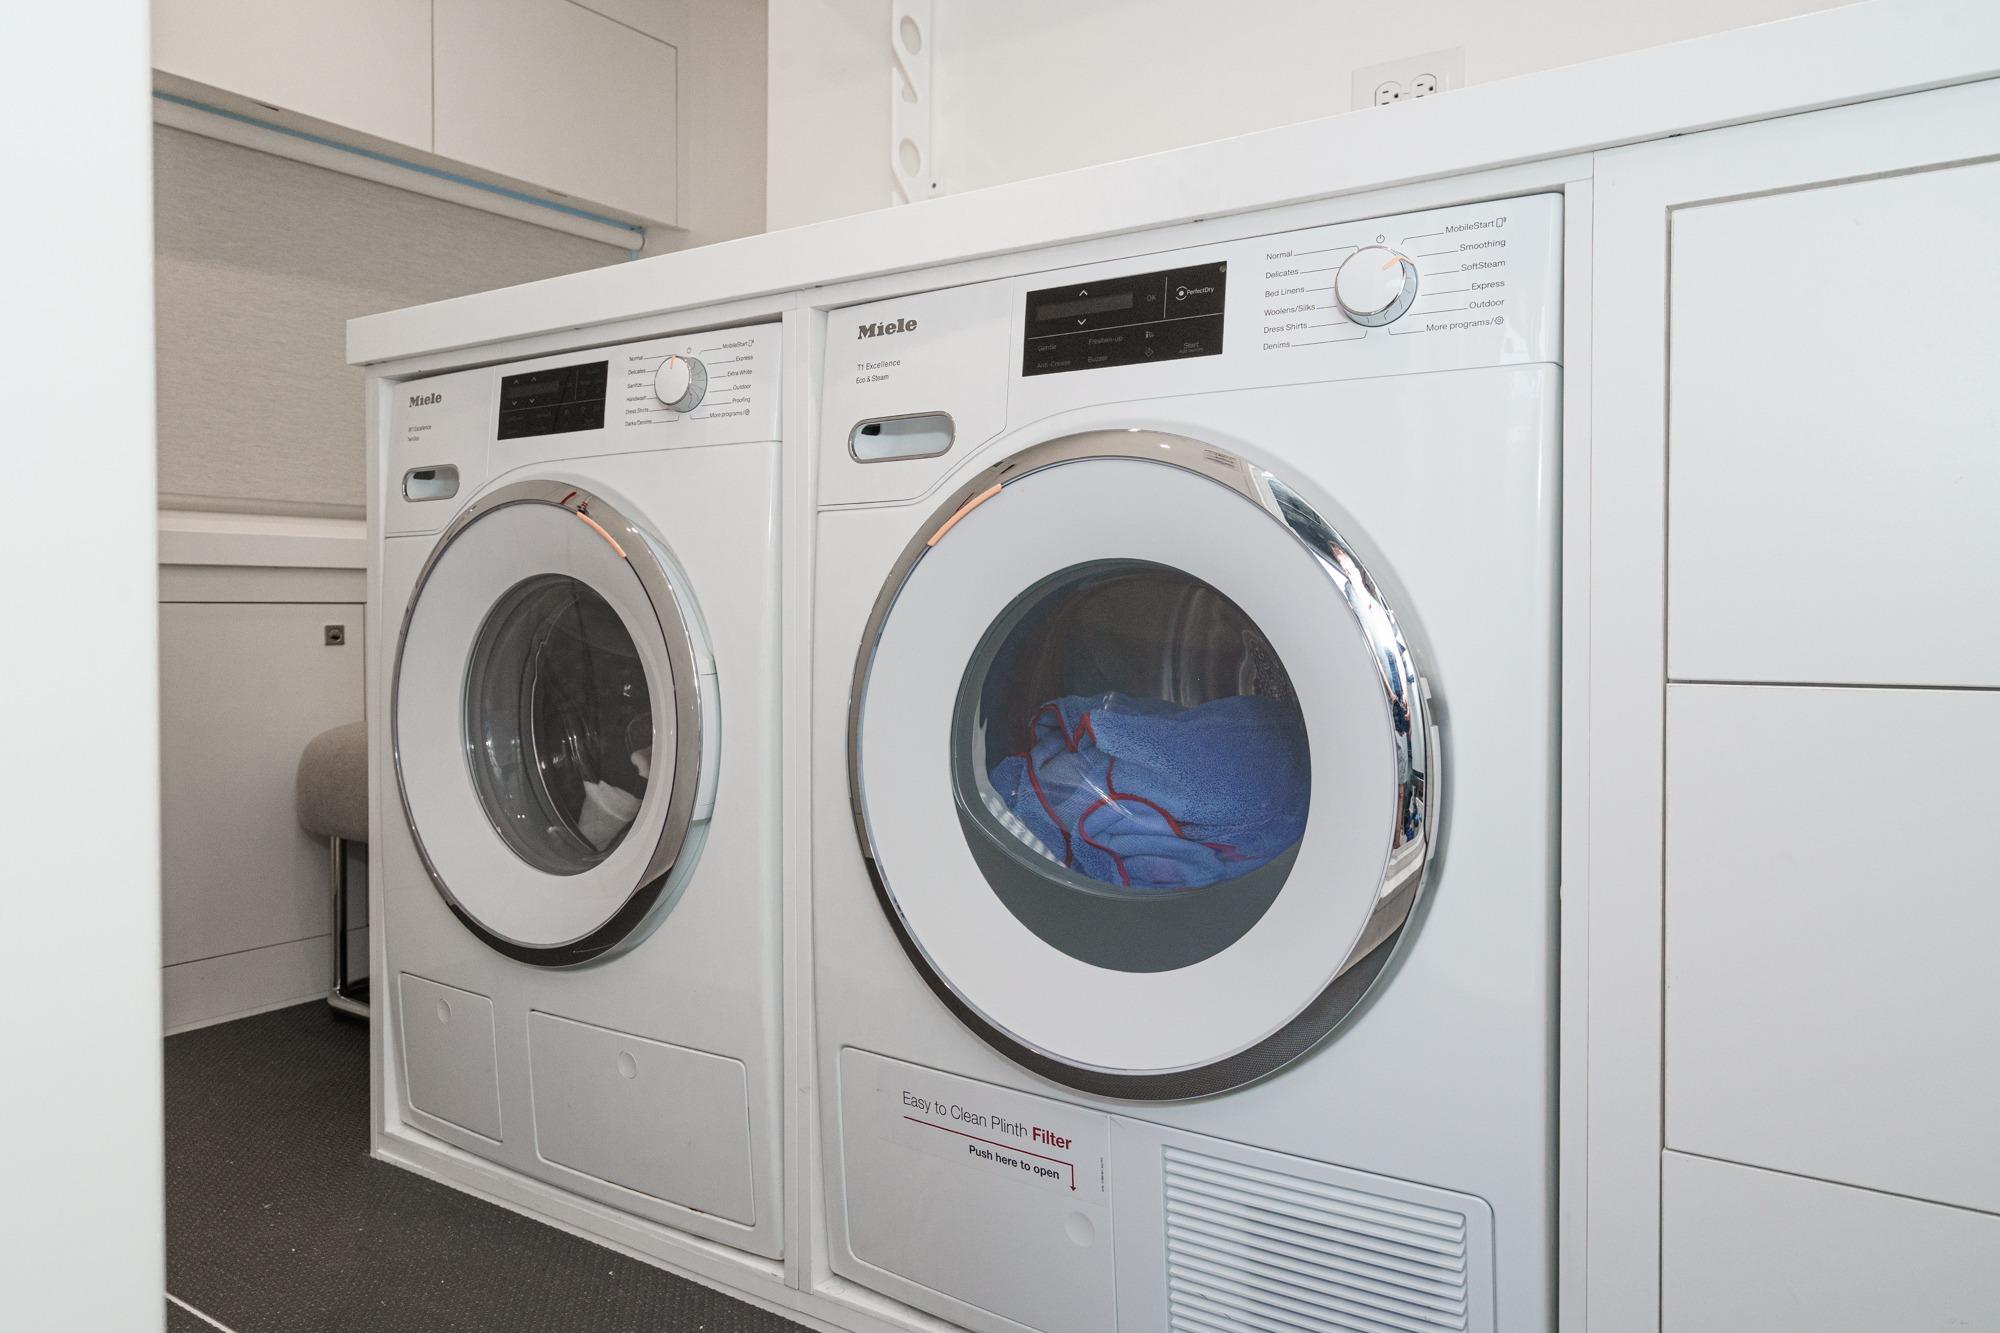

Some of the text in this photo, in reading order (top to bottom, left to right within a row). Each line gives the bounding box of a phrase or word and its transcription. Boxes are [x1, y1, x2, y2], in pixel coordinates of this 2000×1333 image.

[1445, 220, 1494, 234] MobileStart
[1460, 240, 1506, 252] Smoothing
[1266, 250, 1293, 260] Normal
[1460, 260, 1506, 272] SoftSteam
[1265, 268, 1299, 279] Delicates
[1186, 286, 1214, 296] PerfectDry
[1264, 286, 1305, 298] Bed Linens
[1471, 280, 1505, 292] Express
[1264, 304, 1316, 316] Woolens/Silks
[1469, 299, 1505, 310] Outdoor
[857, 318, 918, 340] Miele
[1263, 322, 1308, 334] Dress Shirts
[1426, 323, 1448, 332] More
[1262, 341, 1291, 351] Denims
[866, 360, 901, 370] Excellence
[409, 392, 442, 408] Miele
[902, 1090, 1073, 1150] Easy to Clean Plinth Filter
[968, 1144, 1060, 1180] Push here to open
